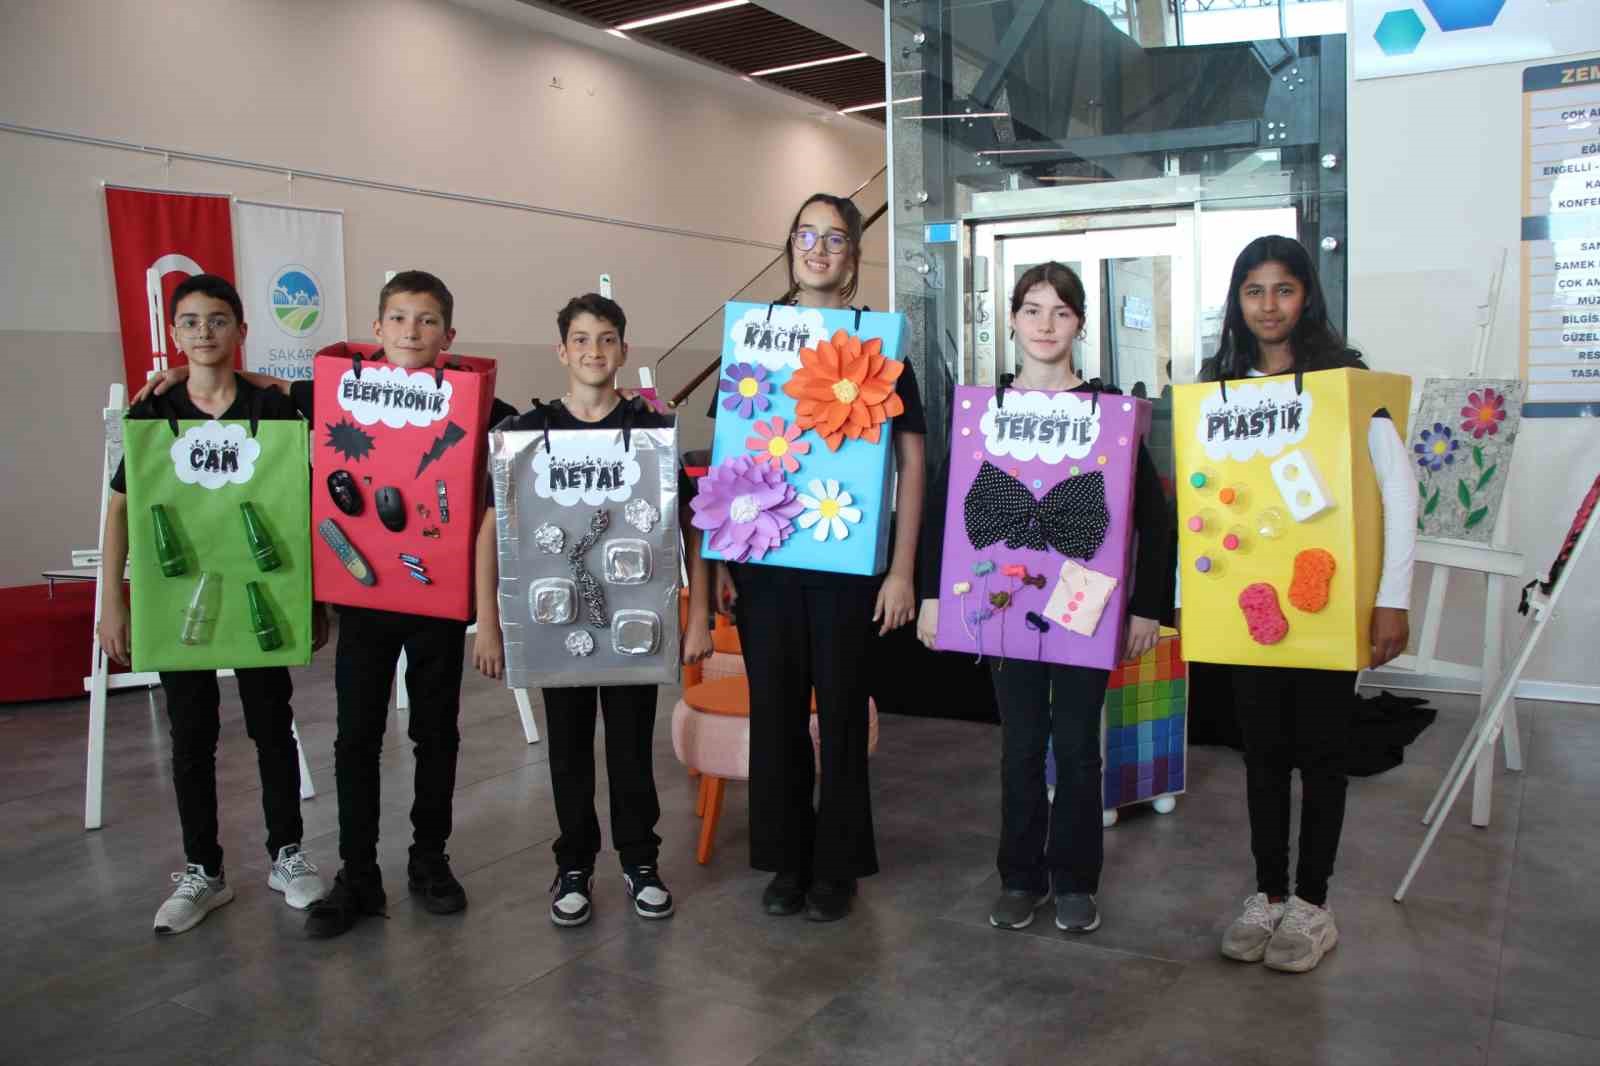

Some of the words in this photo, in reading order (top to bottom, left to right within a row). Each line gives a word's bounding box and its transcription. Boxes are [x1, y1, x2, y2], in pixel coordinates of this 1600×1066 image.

[1558, 197, 1600, 208] KONFE
[743, 324, 810, 352] KAĞIT
[342, 381, 446, 414] ELEKTRONİK
[995, 411, 1092, 446] TEKSTİL
[1207, 402, 1303, 441] PLASTİK
[189, 443, 240, 473] CAM
[549, 459, 625, 491] METAL
